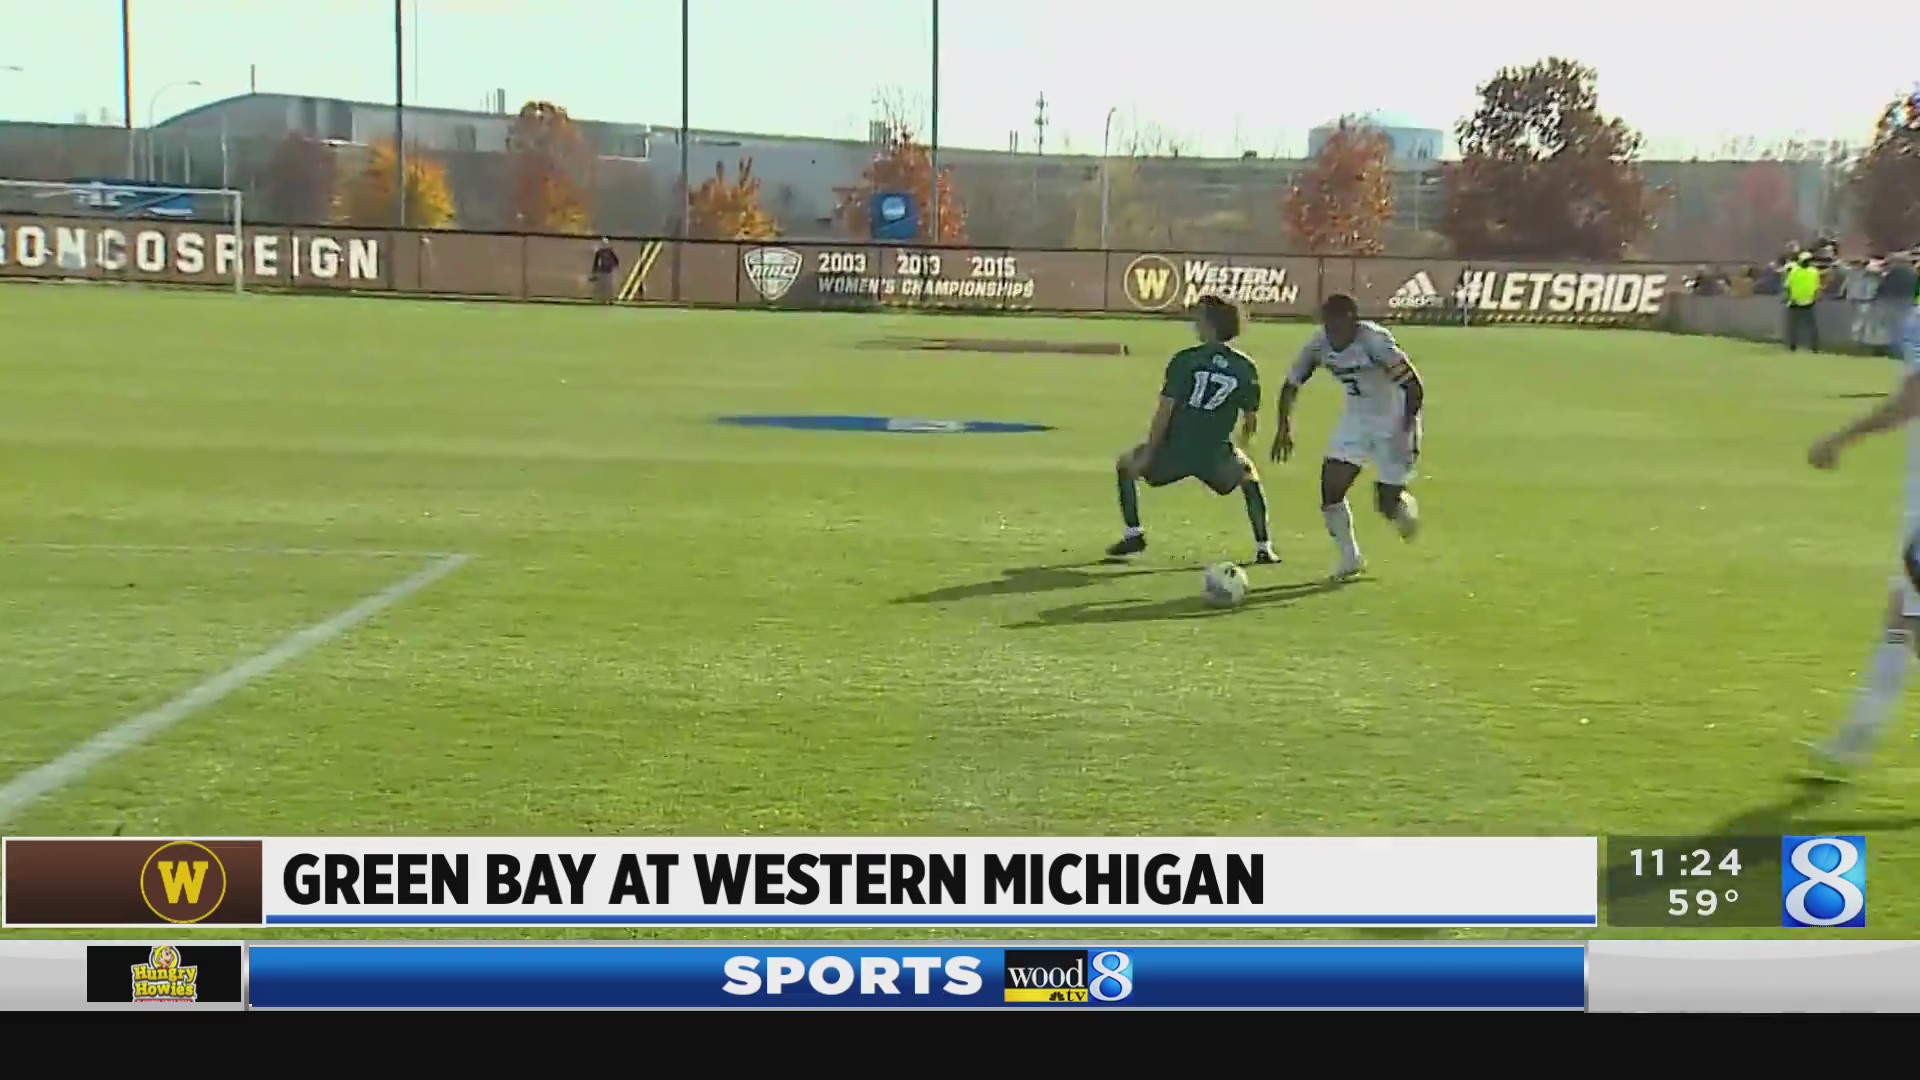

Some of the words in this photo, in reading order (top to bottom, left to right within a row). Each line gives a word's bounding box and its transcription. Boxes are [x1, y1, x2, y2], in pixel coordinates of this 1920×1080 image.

[0, 226, 379, 280] ONCOSREIGN
[818, 253, 866, 273] 2003
[897, 255, 941, 275] 2013
[971, 257, 1016, 277] 2015
[818, 277, 895, 294] WOMEN'S
[901, 278, 1034, 299] CHAMPIONSHIPS
[1134, 268, 1170, 299] W
[1452, 269, 1667, 313] #LETSRIDE
[1188, 371, 1237, 410] 17
